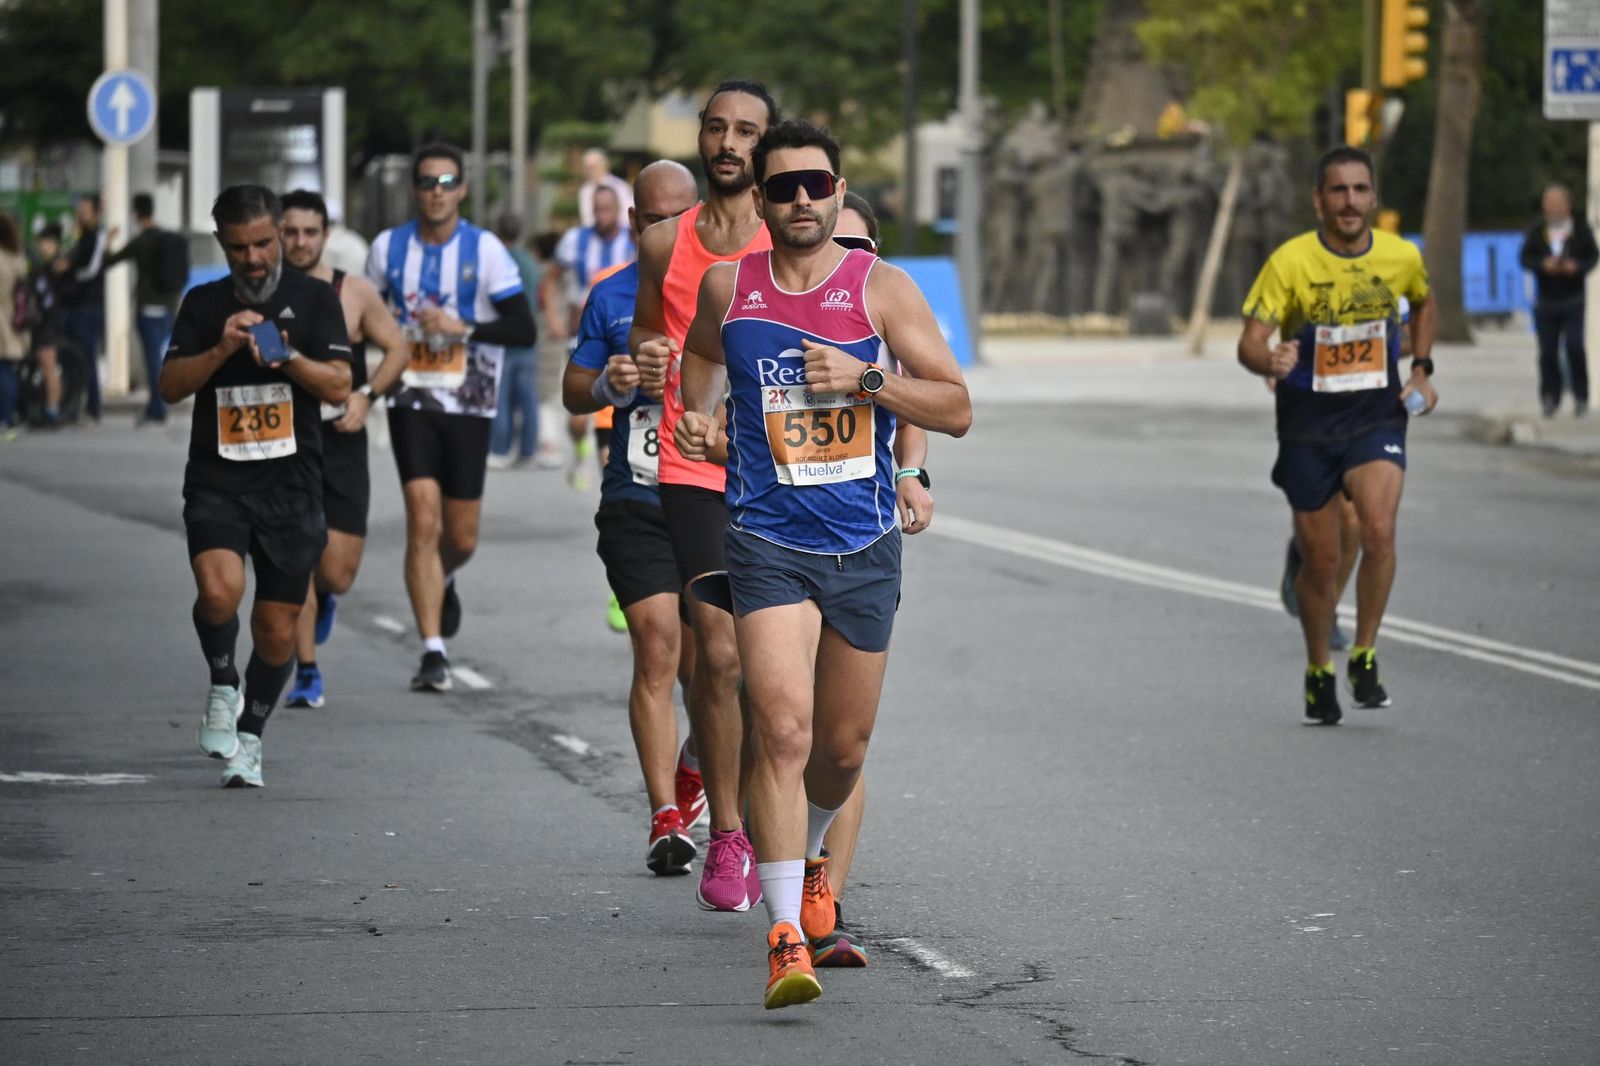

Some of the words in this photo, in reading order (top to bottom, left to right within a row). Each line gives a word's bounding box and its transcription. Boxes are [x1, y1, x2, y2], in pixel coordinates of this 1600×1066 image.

[1326, 341, 1373, 367] 332
[768, 389, 791, 404] 2K
[229, 404, 281, 433] 236
[783, 408, 856, 448] 550
[798, 462, 843, 477] Huelva
